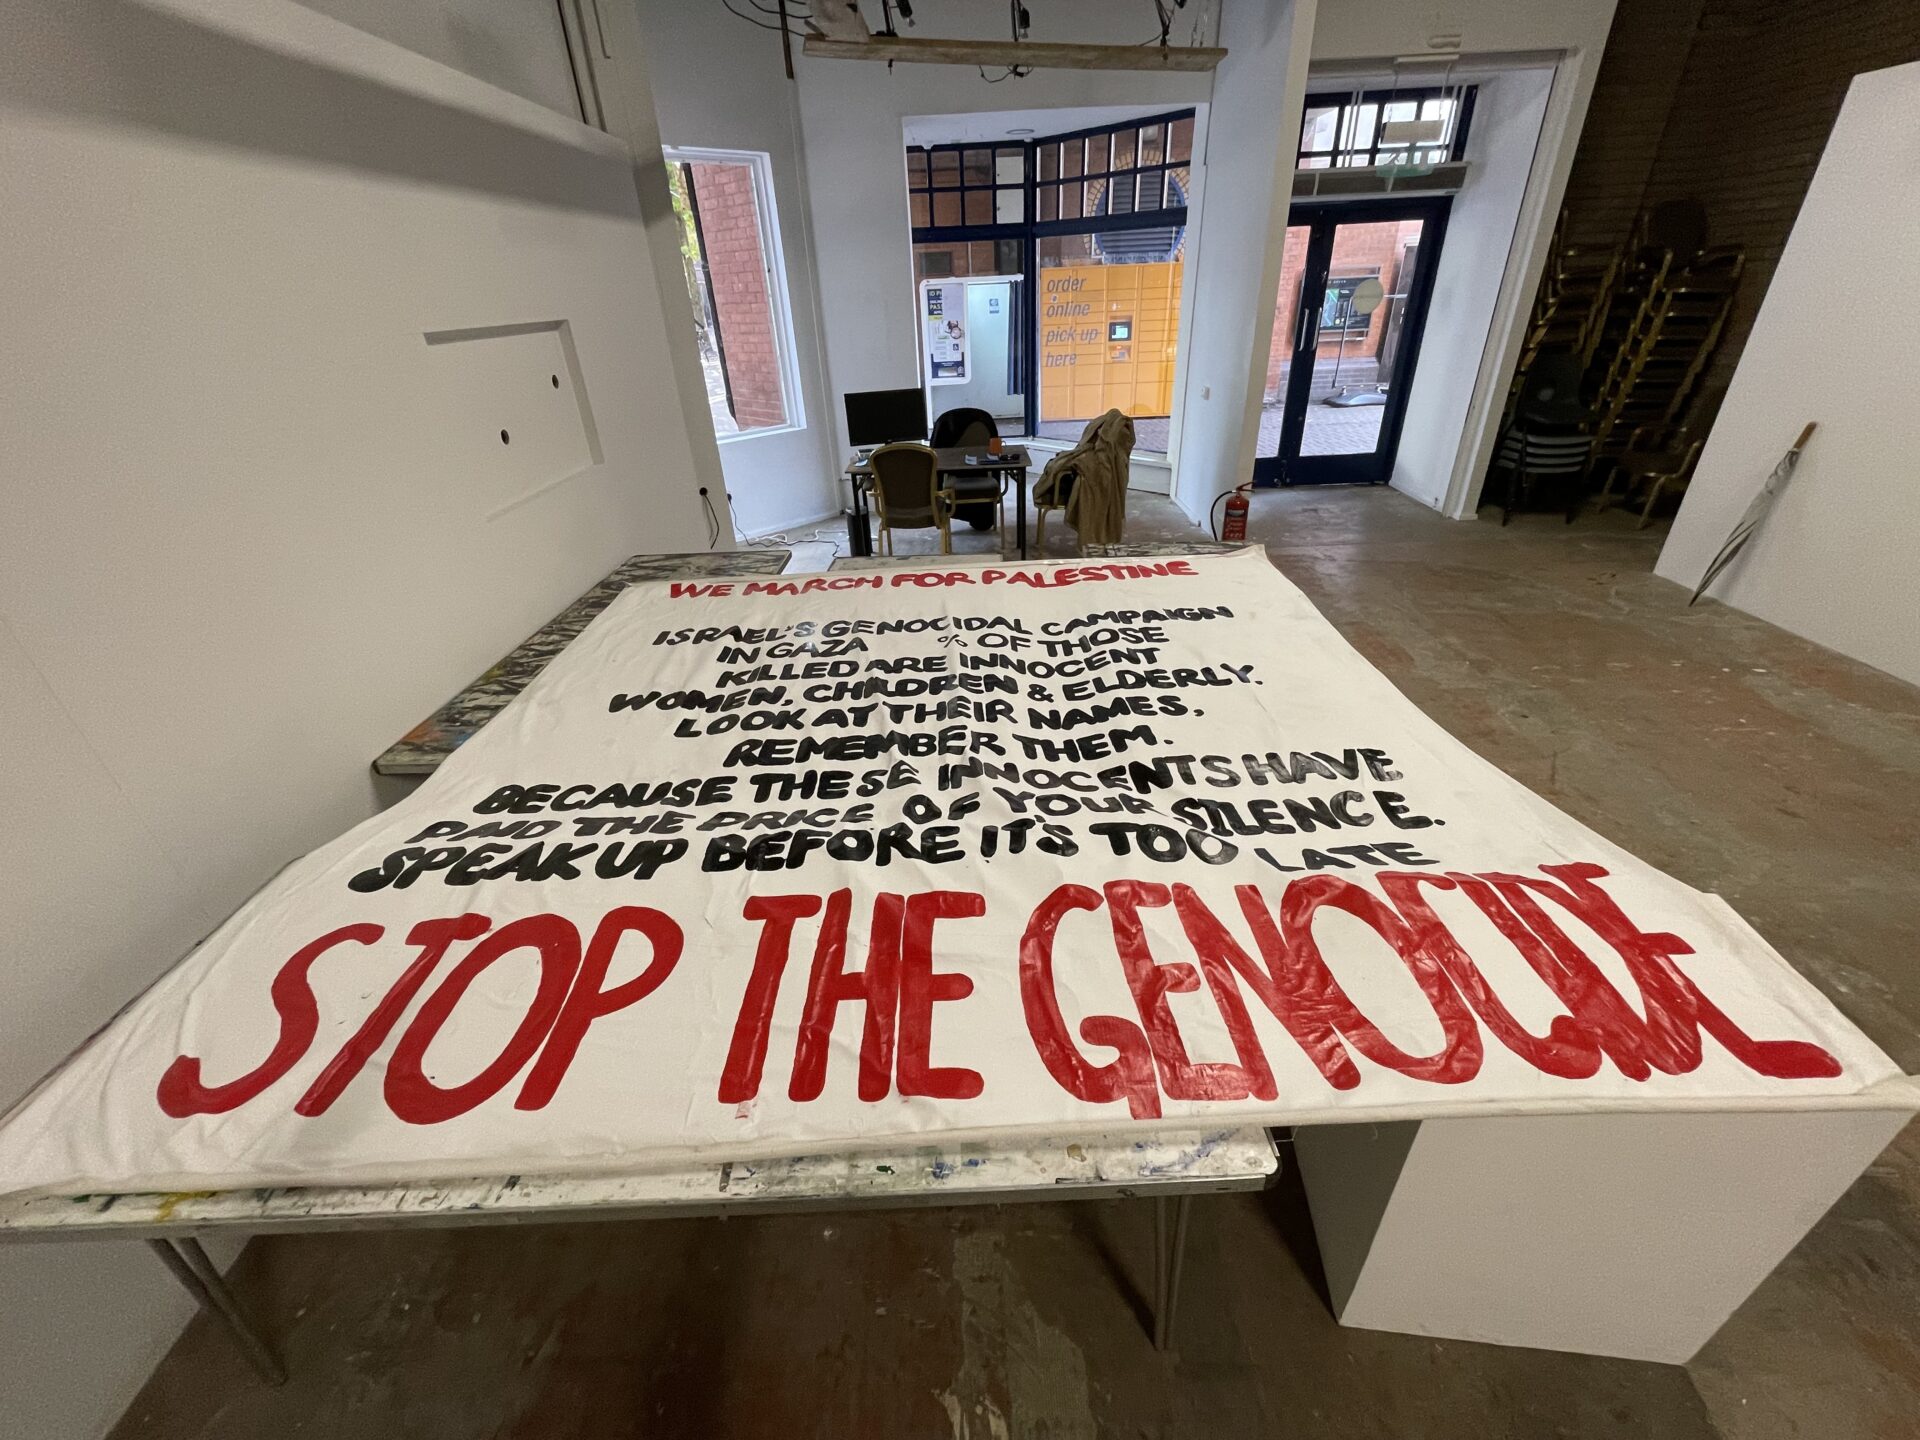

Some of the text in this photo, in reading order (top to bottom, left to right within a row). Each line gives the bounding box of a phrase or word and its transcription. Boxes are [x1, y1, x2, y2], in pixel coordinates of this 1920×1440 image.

[1047, 276, 1087, 293] order
[1046, 301, 1090, 318] online
[1045, 326, 1098, 347] pick up
[1045, 352, 1076, 367] here
[670, 561, 1199, 599] WE MARCH FOR PALESTINE
[652, 605, 1235, 646] ISRAEL'S GENOCIDAL CAMPAIGN
[716, 627, 1170, 664] IN GAZA % OF THOSE
[609, 663, 1263, 713] WOMEN, CHILDREN & ELDERLY.
[715, 648, 1160, 688] KILLED ARE INNOCENT
[673, 708, 807, 738] LOOK
[811, 703, 879, 728] AT
[882, 696, 1018, 724] THEIR
[722, 725, 1173, 768] REMEMBER THEM.
[473, 748, 1403, 817] BECAUSE THESE INNOCENTS HAVE
[406, 786, 1446, 845] PAID THE PRICE OF YOUR SILENCE.
[348, 814, 1440, 893] SPEAK UP BEFORE IT'S TOO LATE
[156, 861, 1844, 1125] STOP THE GENOCIDE
